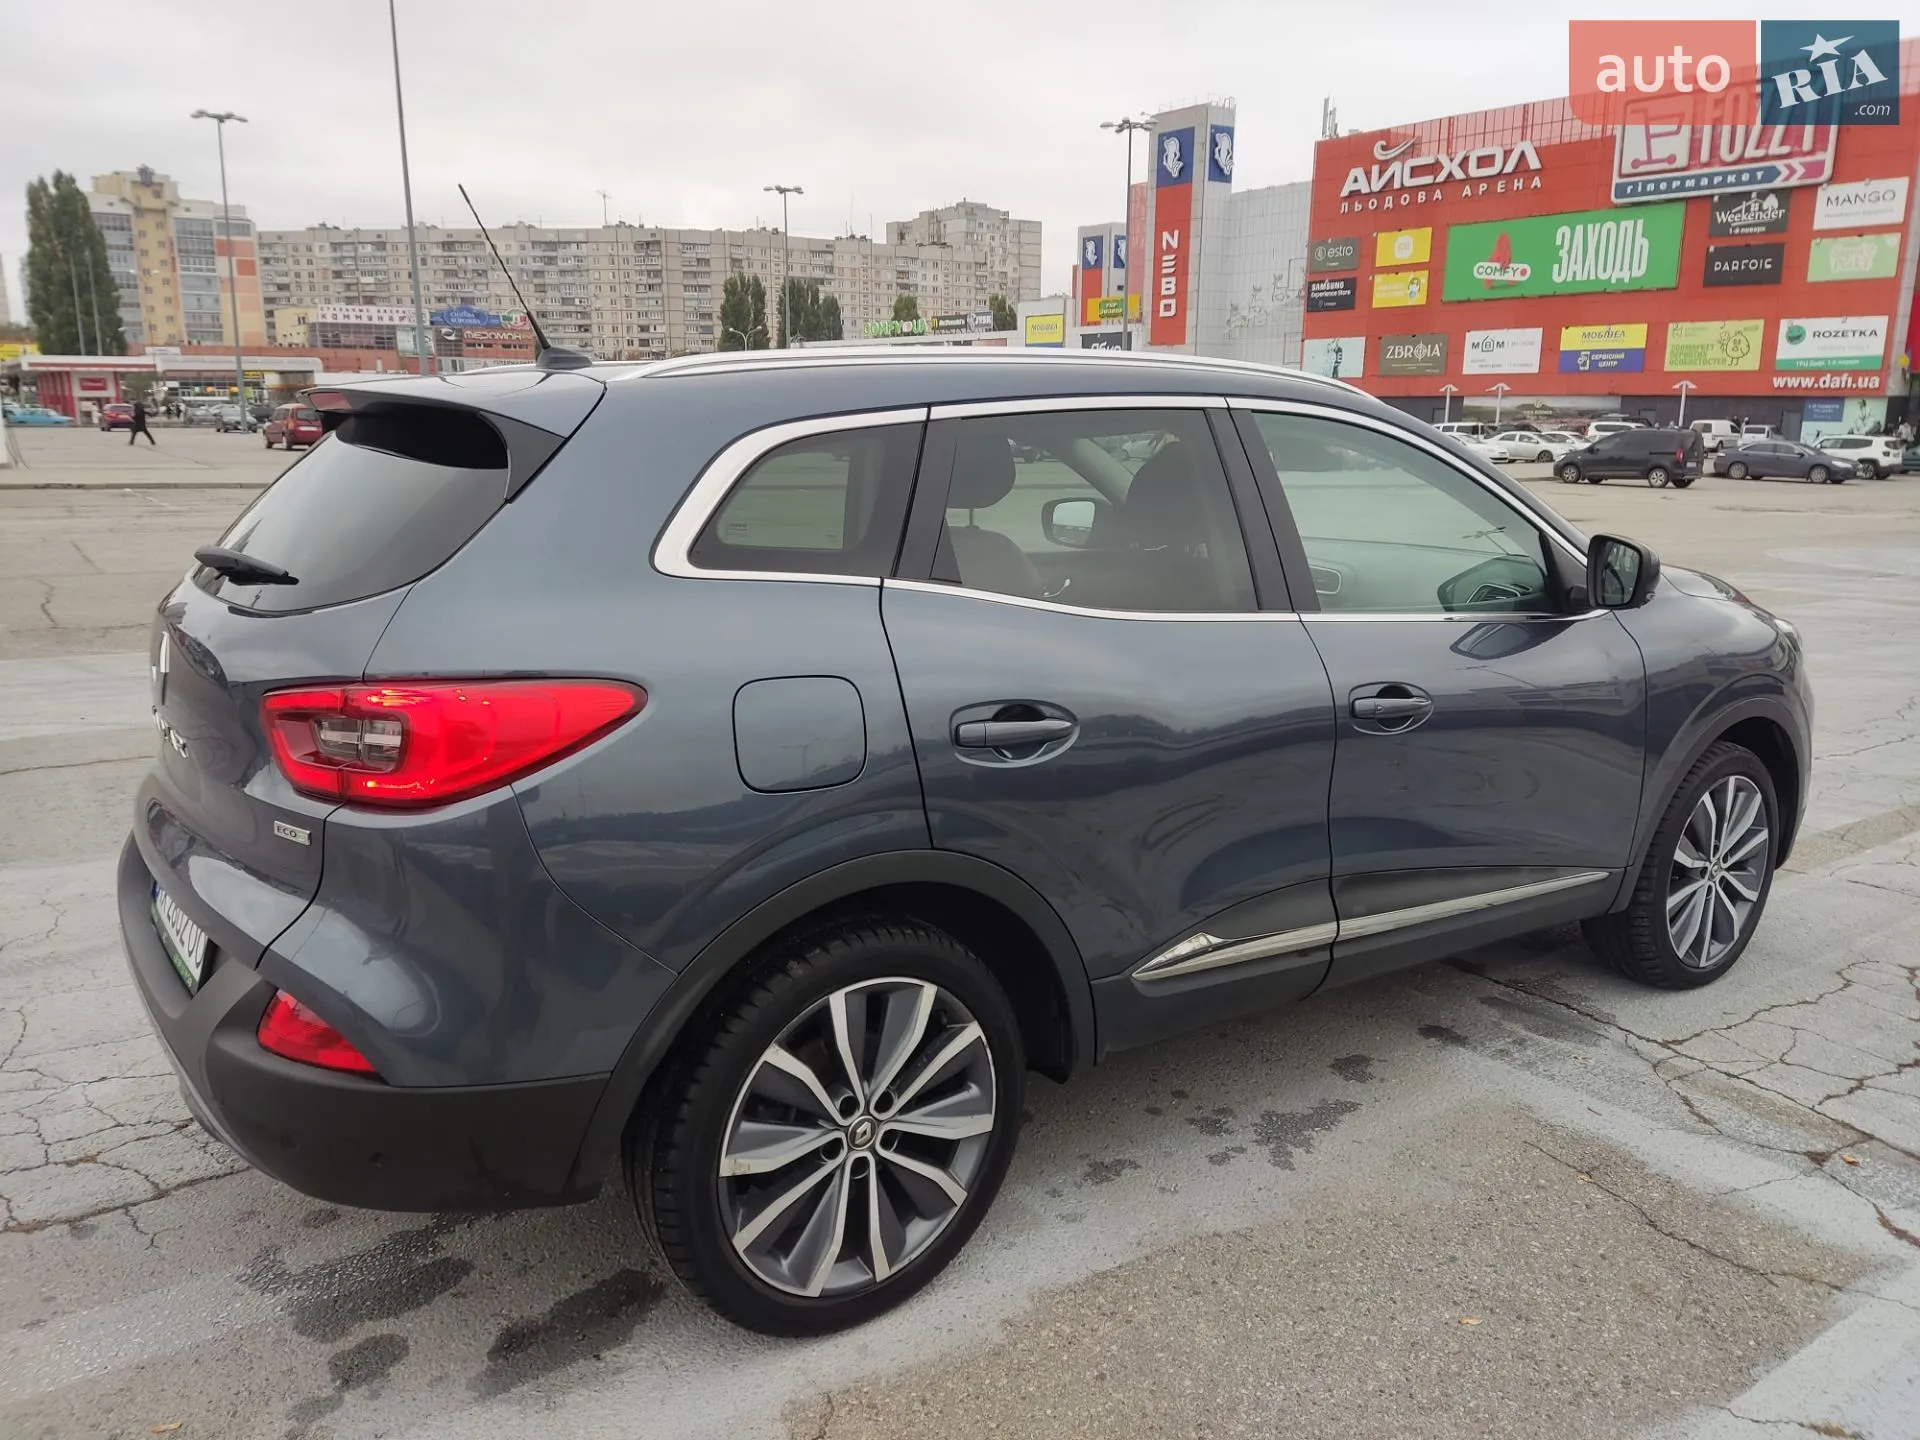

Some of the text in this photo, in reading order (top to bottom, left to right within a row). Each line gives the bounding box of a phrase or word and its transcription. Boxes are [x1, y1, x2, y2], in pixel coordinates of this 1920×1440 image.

[1340, 176, 1542, 214] ЛЬОДОВА АРЕНА
[1826, 189, 1896, 208] MANGO
[1715, 201, 1786, 225] Weekender
[1327, 245, 1353, 258] estro
[1552, 219, 1649, 284] ЗАХОДЬ
[1476, 265, 1519, 277] COMFY
[1714, 257, 1773, 272] PARFOIS
[1159, 229, 1179, 318] NEBO
[1312, 281, 1345, 291] SAMSUNG
[1311, 289, 1351, 299] Experience Store
[1812, 329, 1878, 339] ROZETKA
[1773, 373, 1880, 389] www.dafi.ua
